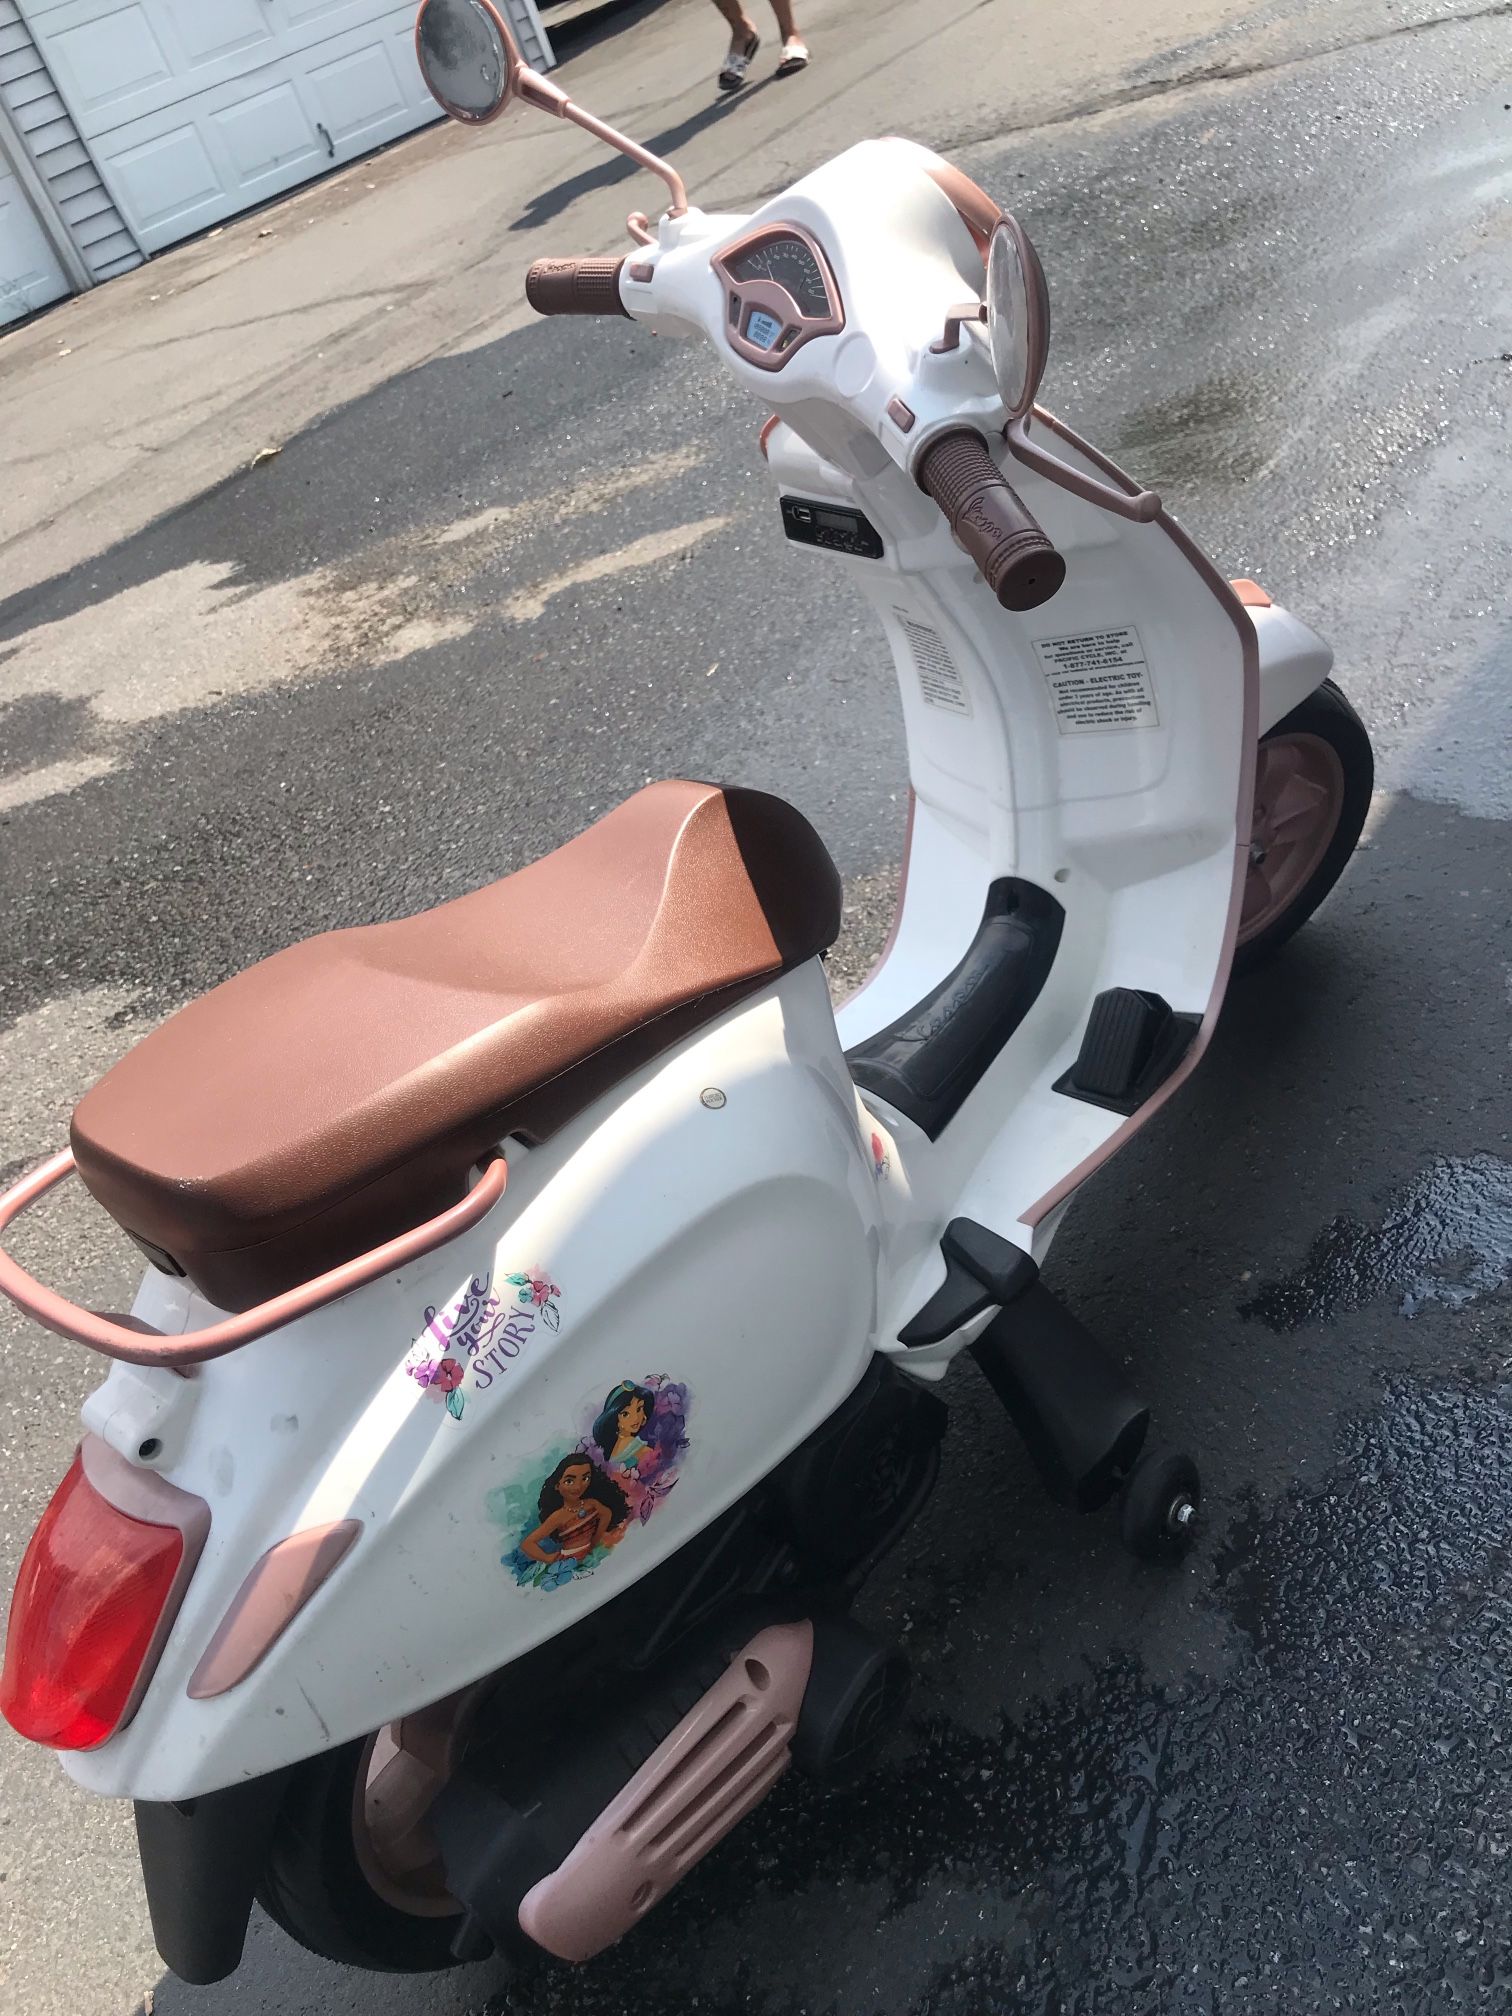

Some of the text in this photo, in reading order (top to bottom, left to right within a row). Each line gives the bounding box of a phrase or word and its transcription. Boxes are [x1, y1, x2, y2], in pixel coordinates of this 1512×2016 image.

[961, 496, 1002, 539] Vespa
[1052, 679, 1085, 688] CAUTION
[1090, 675, 1125, 684] ELECTRIC
[1063, 656, 1123, 669] 1-877-741-6154
[457, 1287, 506, 1357] your
[472, 1305, 536, 1390] STORY
